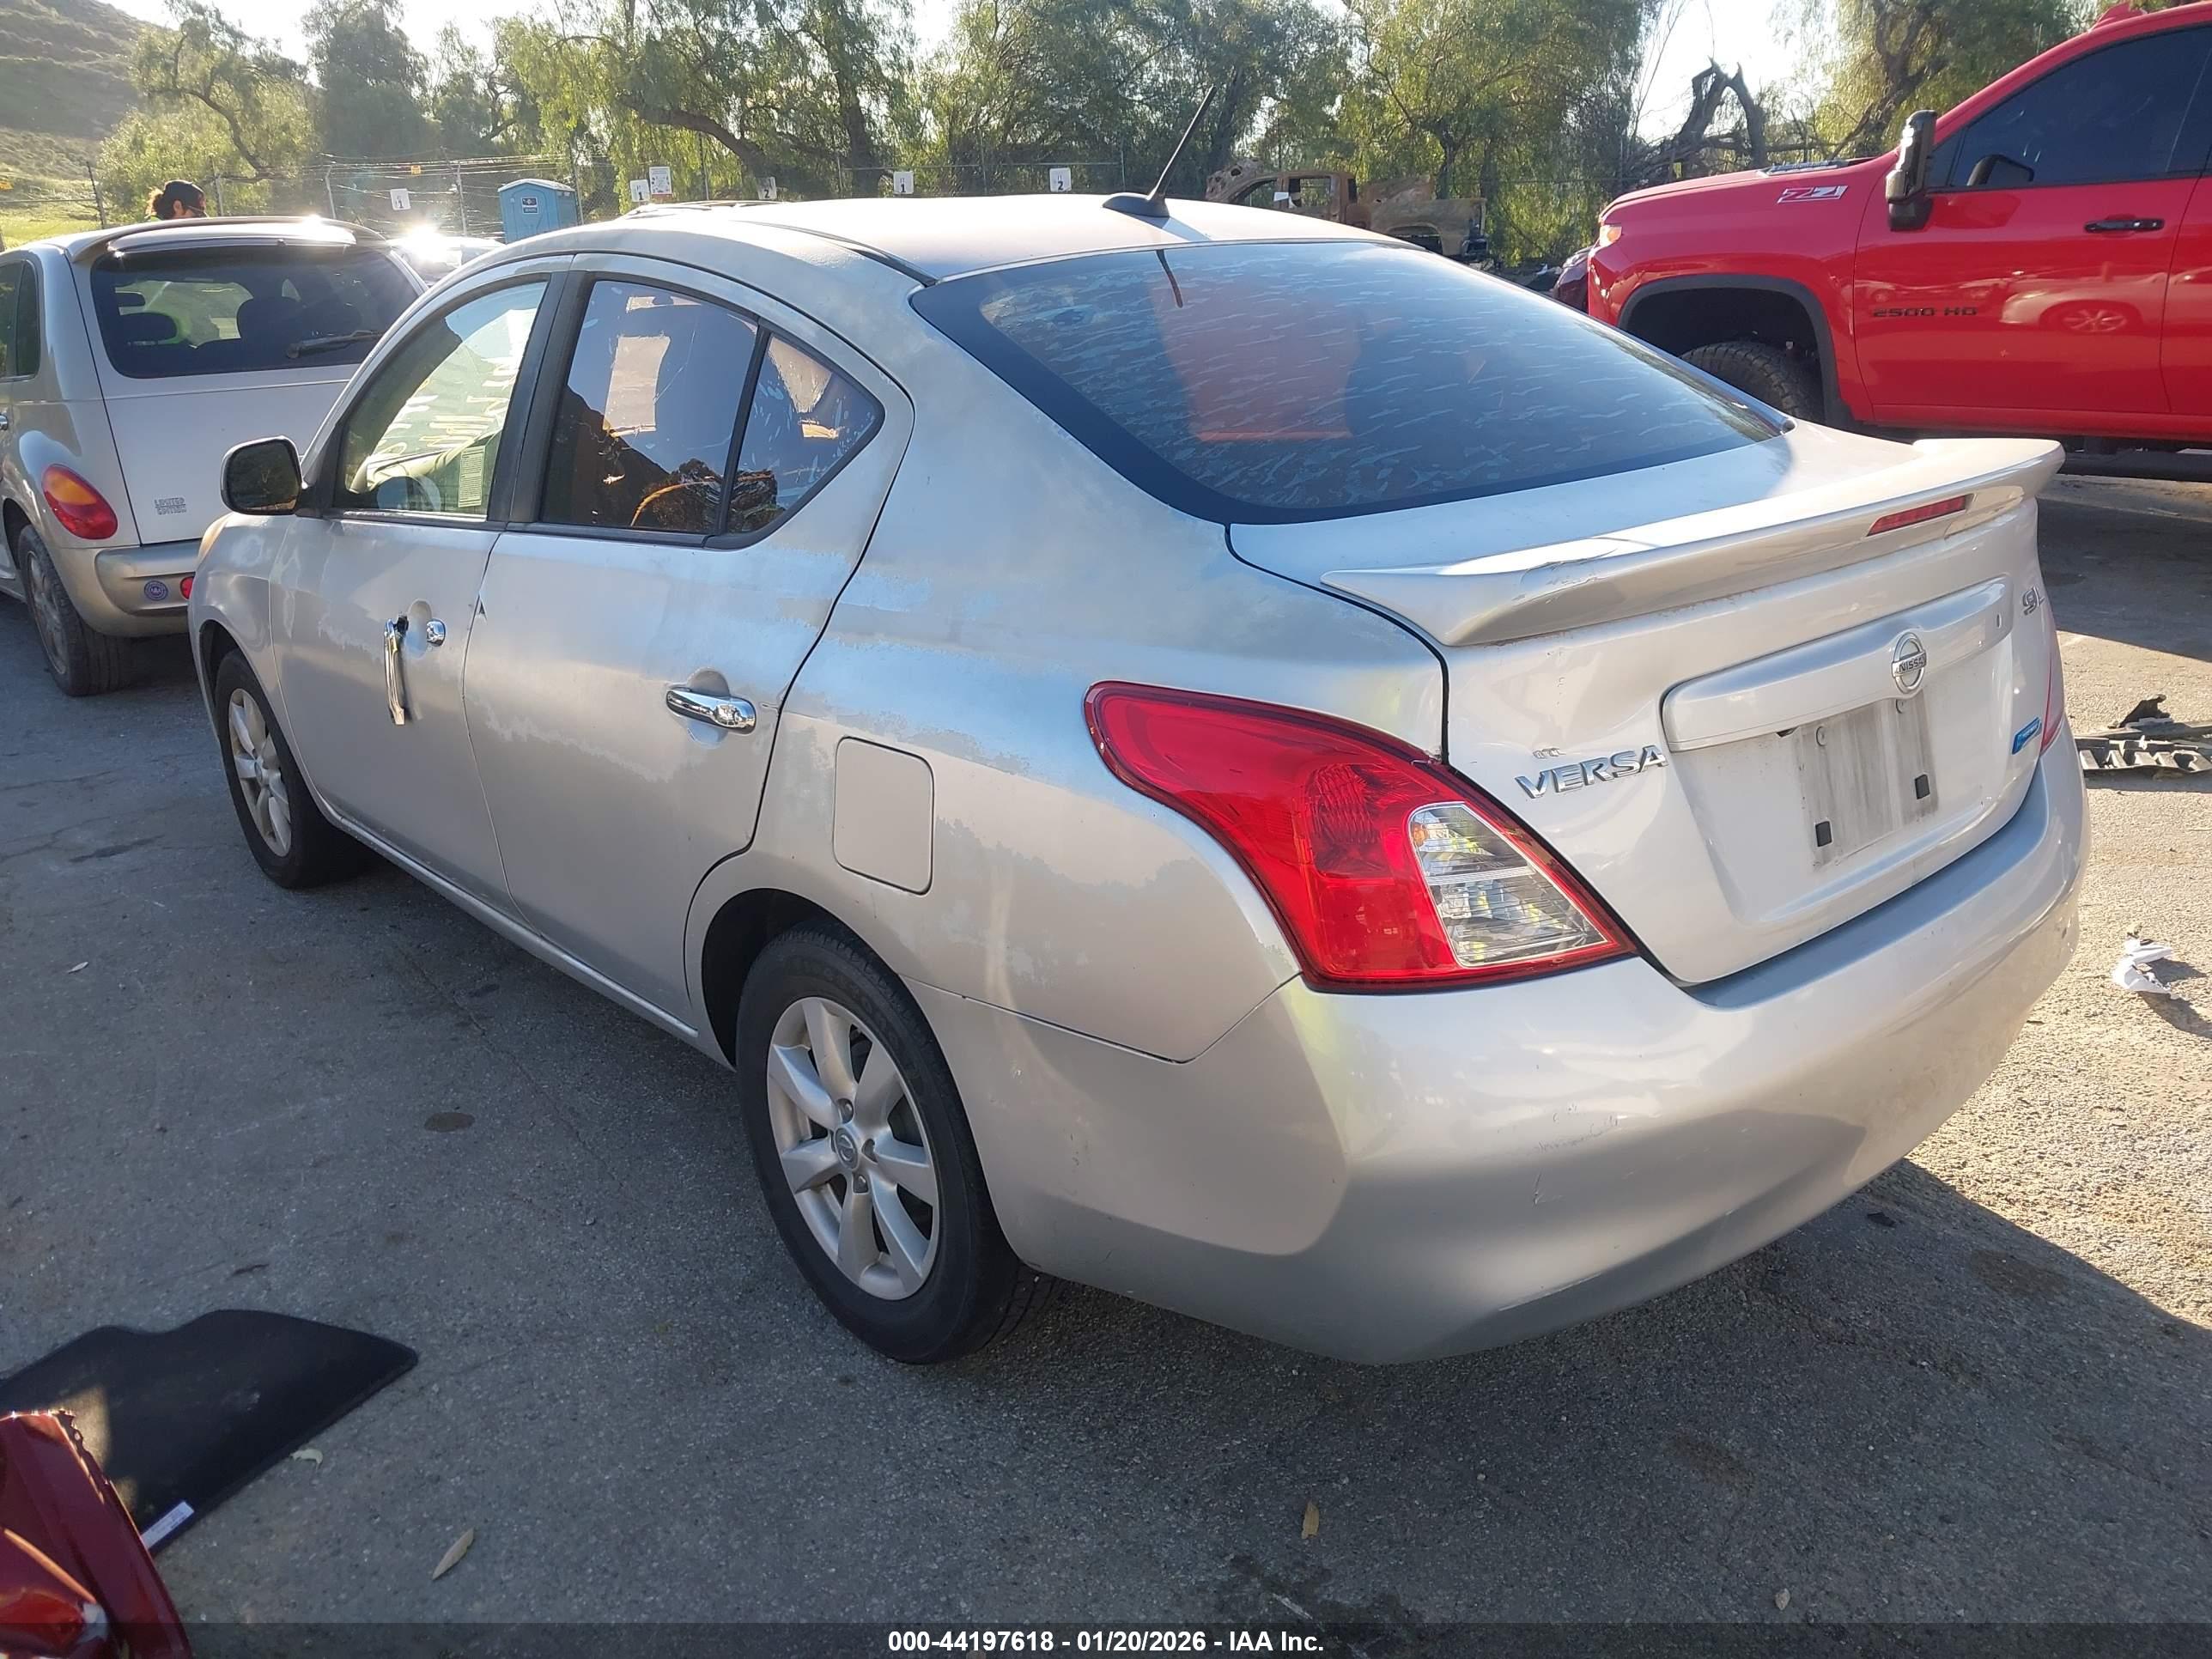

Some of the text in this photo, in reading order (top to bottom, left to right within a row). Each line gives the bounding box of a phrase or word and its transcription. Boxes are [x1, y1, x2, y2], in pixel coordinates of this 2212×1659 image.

[1057, 180, 1064, 191] 2
[763, 189, 770, 198] 2
[1873, 307, 1979, 318] 2500 HD
[1514, 744, 1669, 799] VERSA
